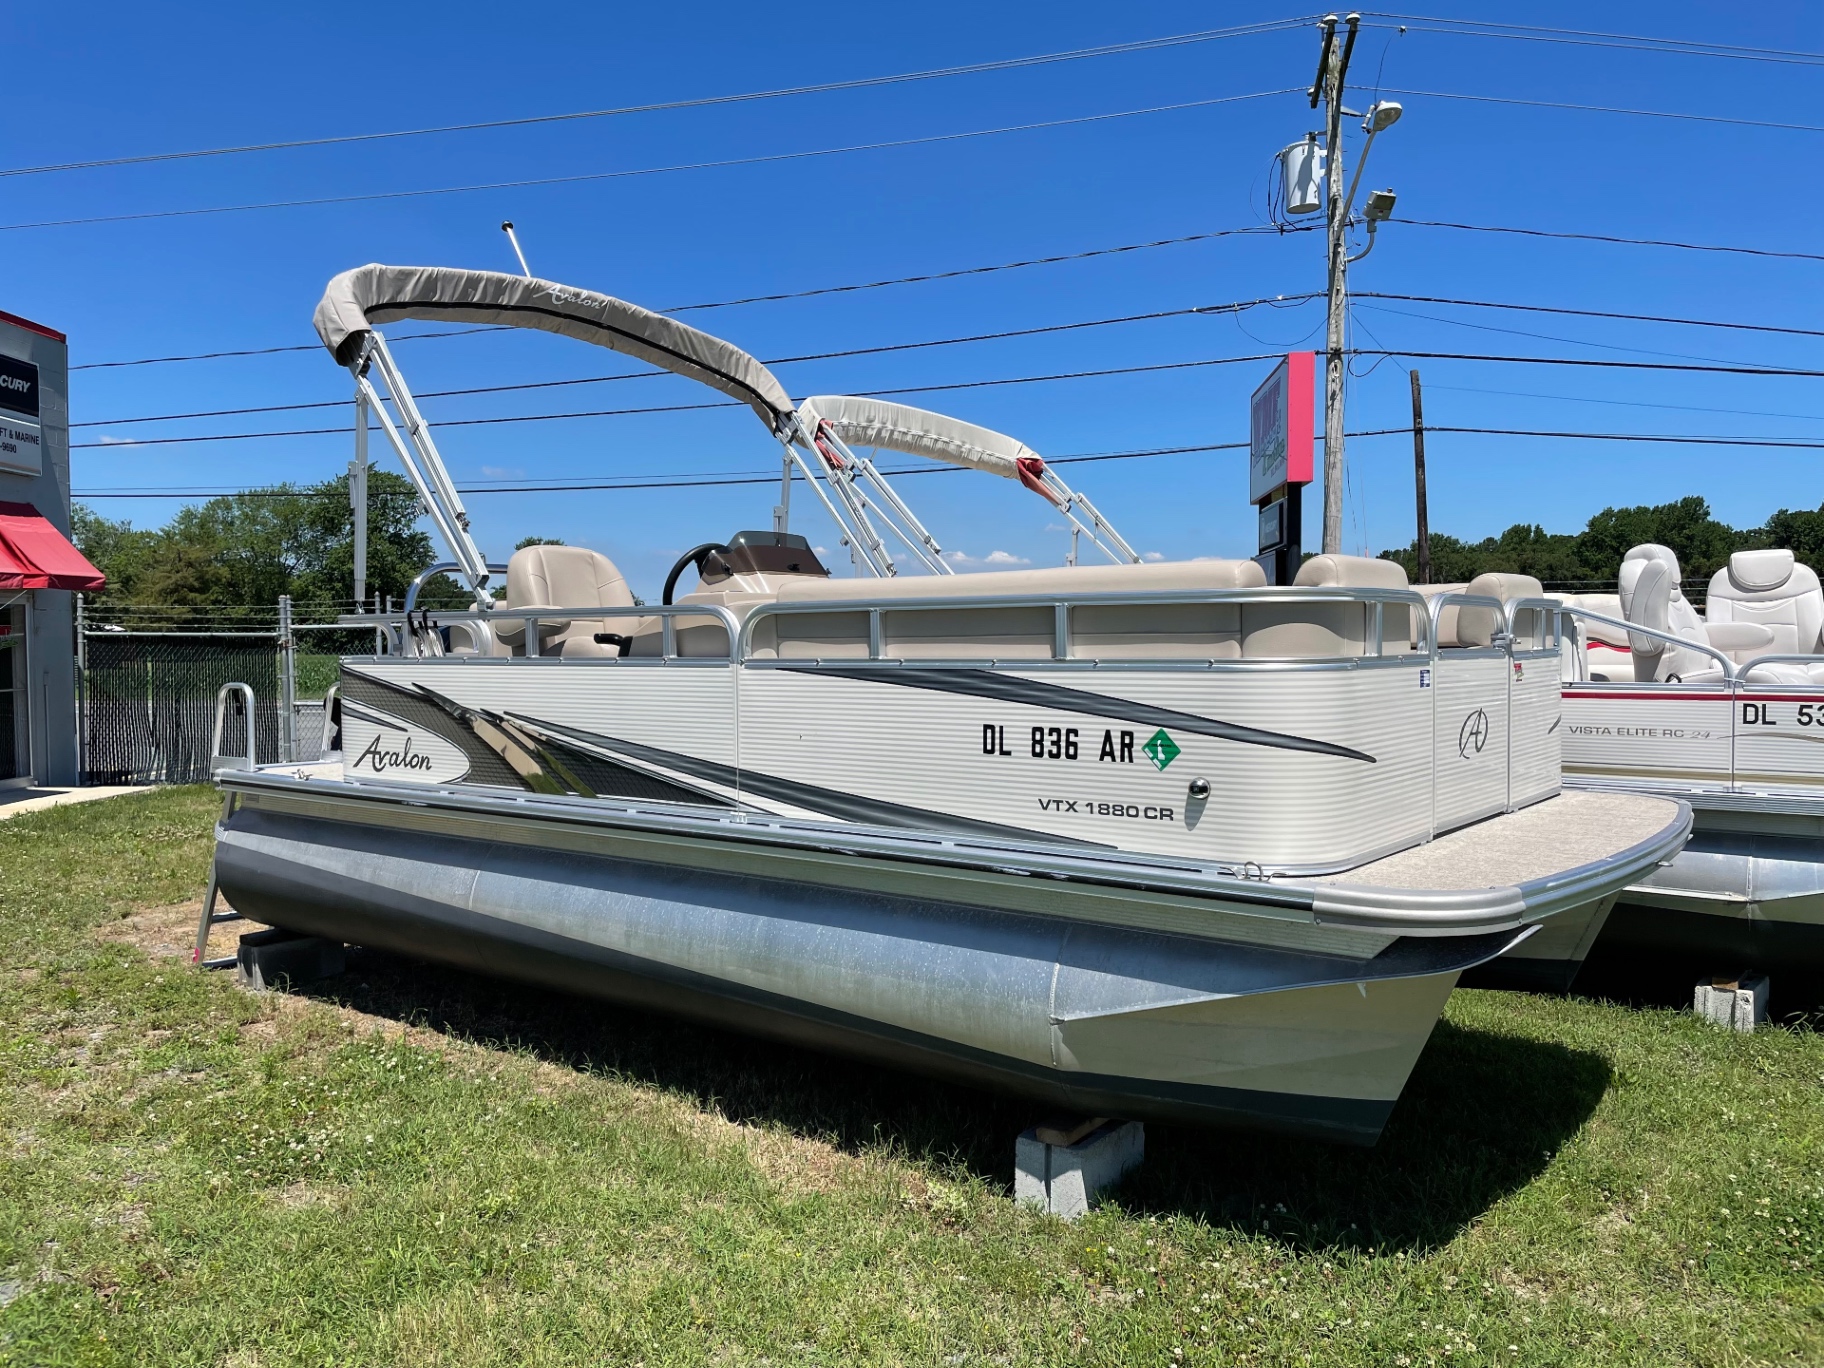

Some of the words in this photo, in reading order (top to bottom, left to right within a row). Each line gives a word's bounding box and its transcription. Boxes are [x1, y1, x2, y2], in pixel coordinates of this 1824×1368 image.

[533, 284, 600, 309] Avalon
[15, 430, 39, 445] MARINE
[1742, 703, 1776, 725] DL
[982, 724, 1012, 756] DL
[1031, 726, 1079, 760] 836
[1099, 729, 1134, 763] AR
[1568, 726, 1612, 736] VISTA
[1616, 727, 1658, 737] ELITE
[1662, 729, 1685, 738] RC
[1689, 730, 1711, 740] 24
[352, 733, 433, 773] Avalon
[1038, 798, 1079, 813] VTX
[1085, 802, 1140, 818] 1880
[1143, 806, 1174, 821] CR
